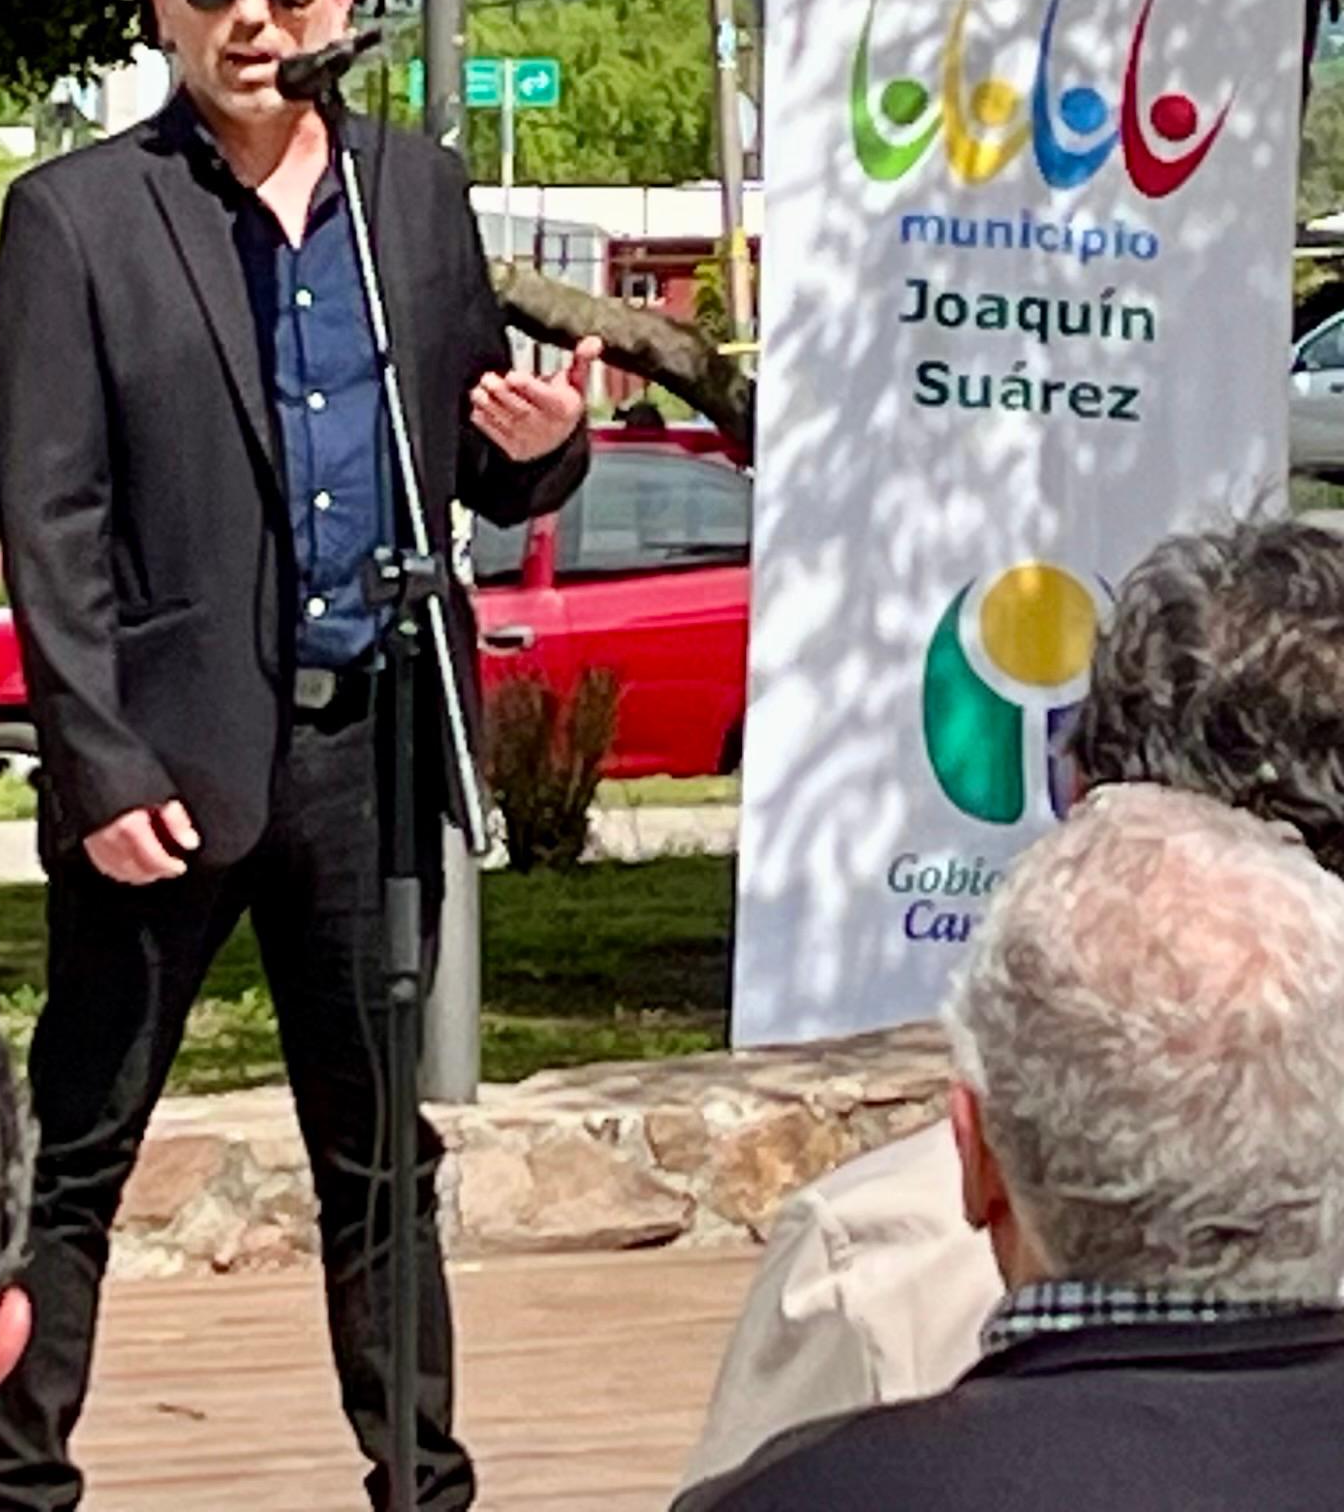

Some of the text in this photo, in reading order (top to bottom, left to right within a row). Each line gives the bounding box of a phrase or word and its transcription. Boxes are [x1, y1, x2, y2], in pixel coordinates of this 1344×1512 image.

[900, 209, 1159, 264] municipio
[899, 278, 1155, 344] Joaquín
[914, 360, 1141, 421] Suárez
